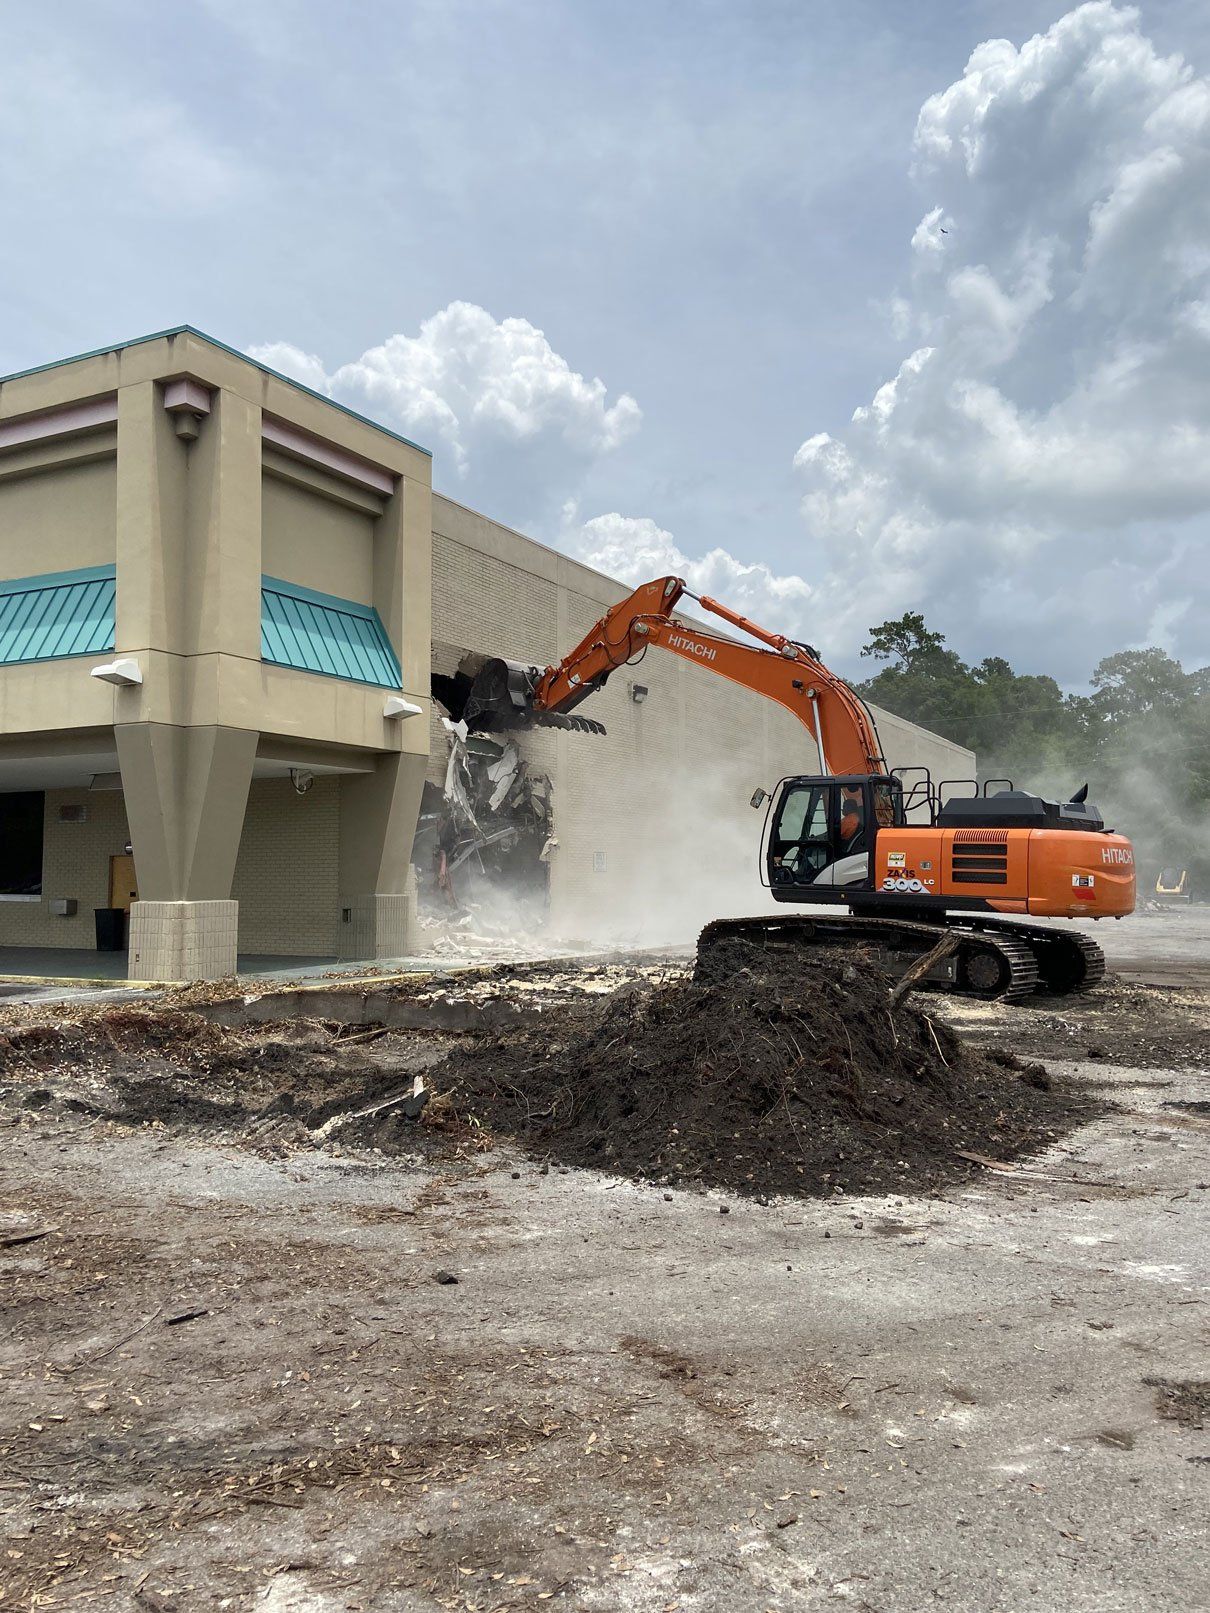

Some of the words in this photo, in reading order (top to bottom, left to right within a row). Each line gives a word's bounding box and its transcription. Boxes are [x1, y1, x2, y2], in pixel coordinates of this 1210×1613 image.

[668, 633, 717, 661] HITACHI
[1101, 847, 1133, 864] HITACH
[882, 877, 922, 892] 300
